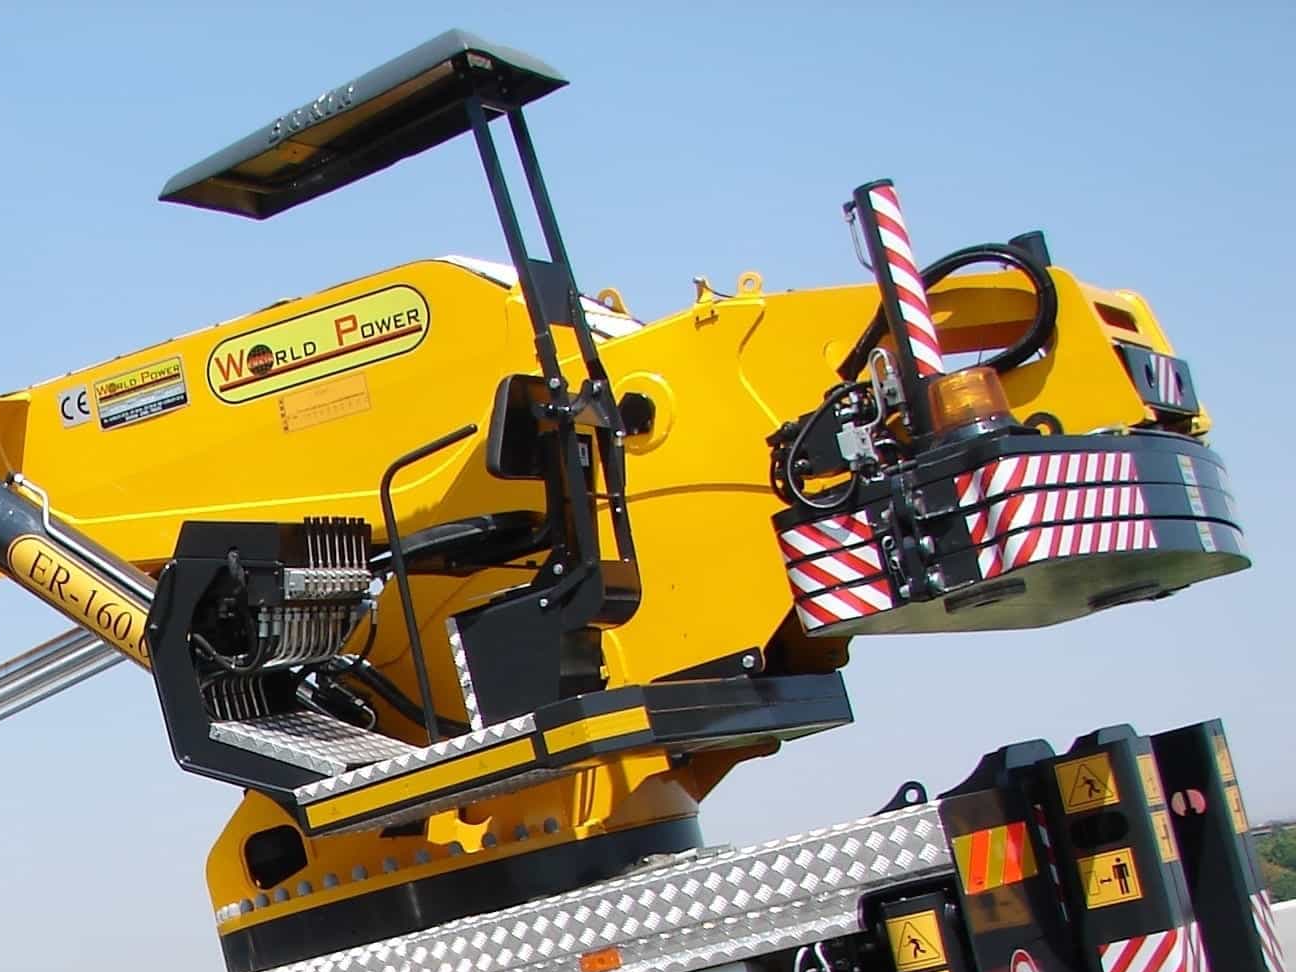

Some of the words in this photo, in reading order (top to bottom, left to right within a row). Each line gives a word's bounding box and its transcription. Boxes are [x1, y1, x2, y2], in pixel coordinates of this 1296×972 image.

[215, 341, 316, 382] WORLD
[334, 308, 420, 346] POWER
[140, 364, 179, 383] POWER
[61, 390, 90, 420] CE
